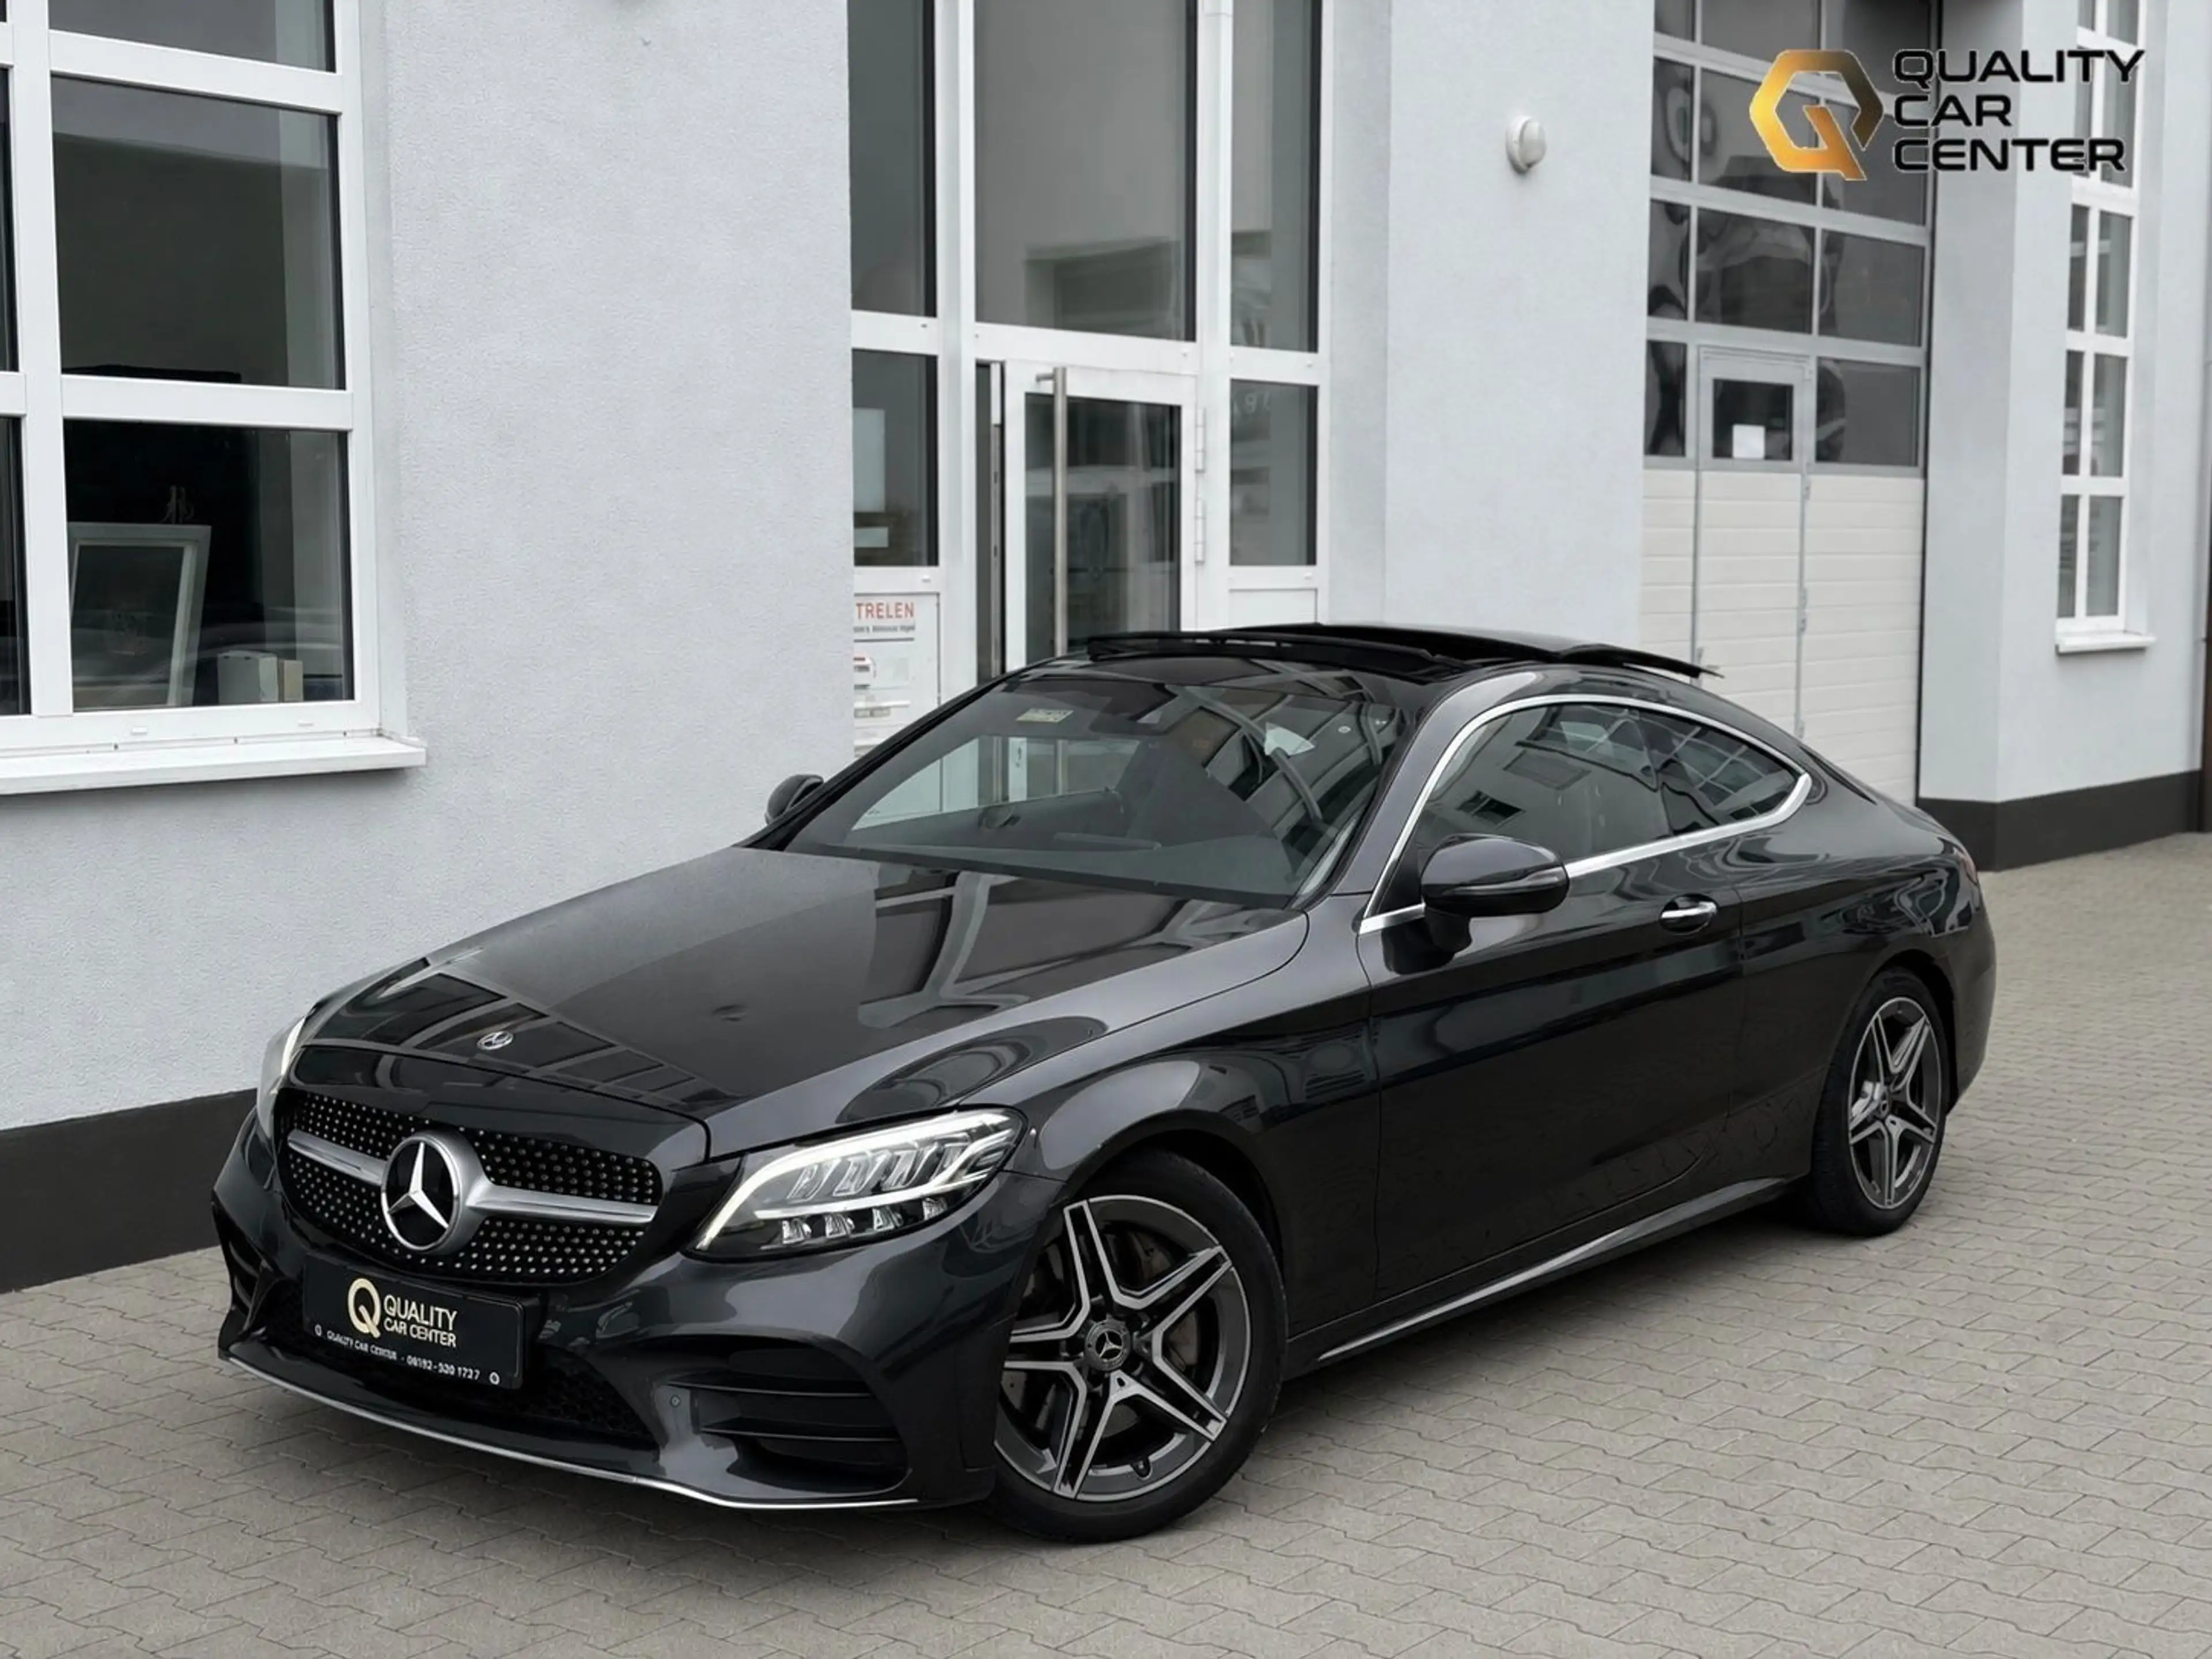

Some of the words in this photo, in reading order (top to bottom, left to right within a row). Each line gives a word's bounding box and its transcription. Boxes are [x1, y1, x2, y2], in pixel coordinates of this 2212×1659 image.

[348, 1278, 381, 1339] Q
[383, 1294, 458, 1331] QUALITY
[354, 1339, 369, 1353] CAR
[383, 1317, 407, 1336] CAR
[409, 1324, 456, 1348] CENTER
